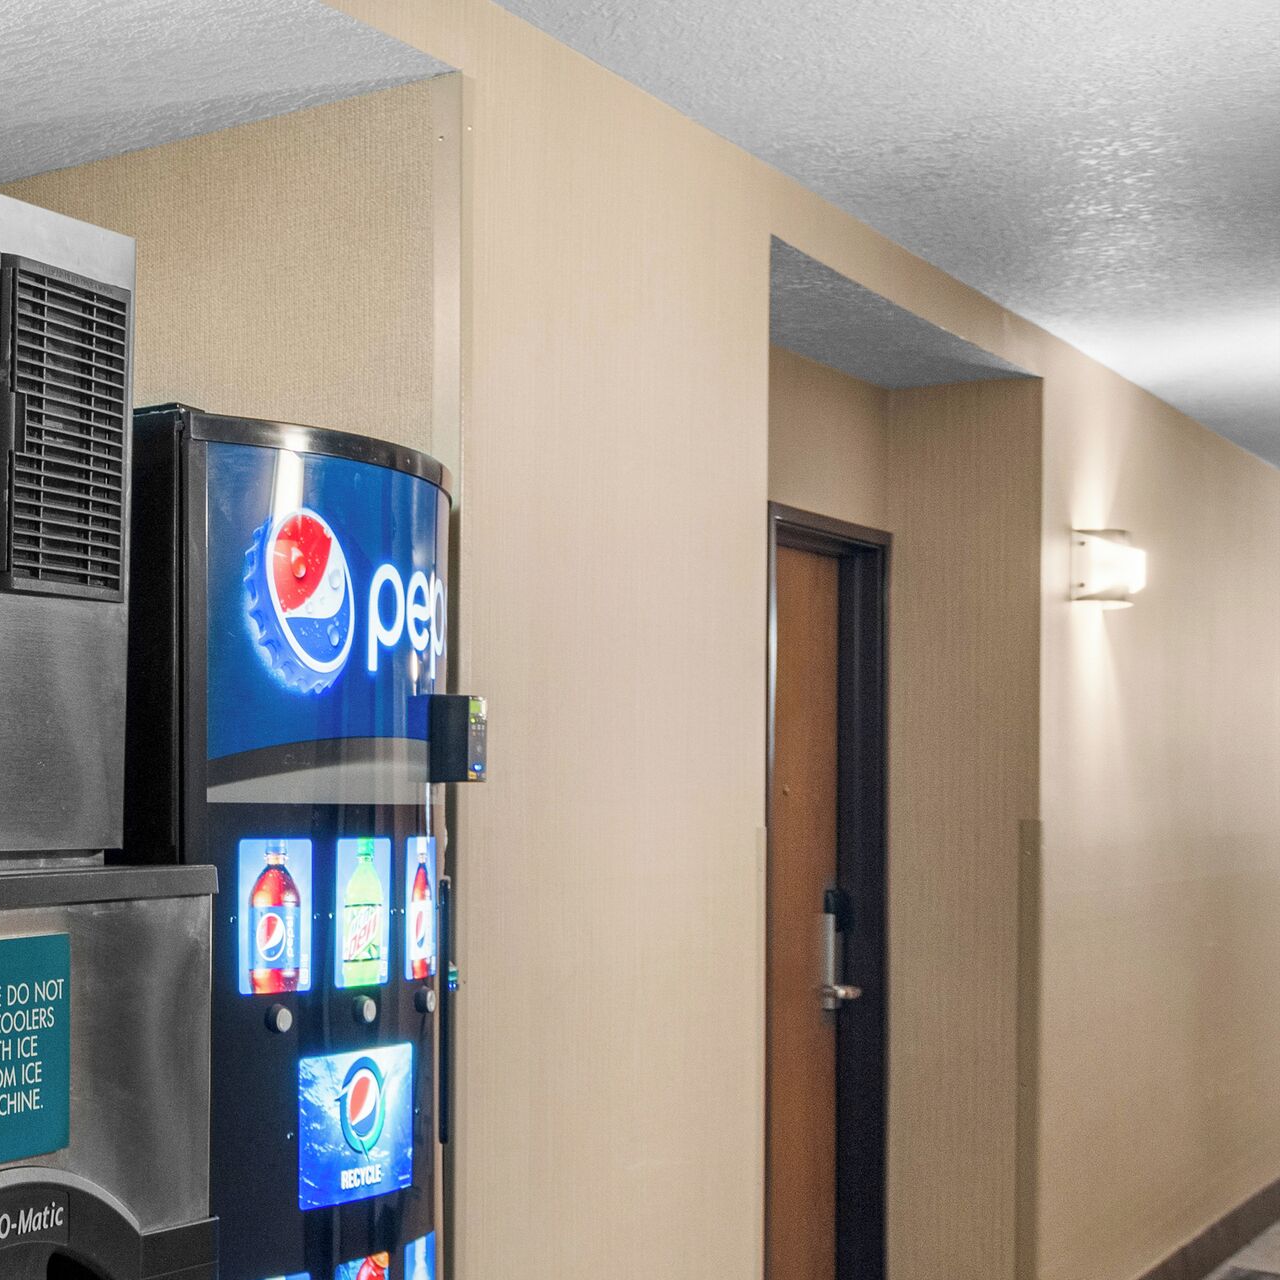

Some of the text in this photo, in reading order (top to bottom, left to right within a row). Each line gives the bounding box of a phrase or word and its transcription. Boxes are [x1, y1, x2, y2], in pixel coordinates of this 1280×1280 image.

[285, 914, 295, 959] pepsi
[7, 983, 30, 1006] DO
[34, 978, 64, 1002] NOT
[16, 1035, 38, 1058] ICE
[21, 1061, 42, 1085] ICE
[340, 1164, 382, 1190] RECYCLE
